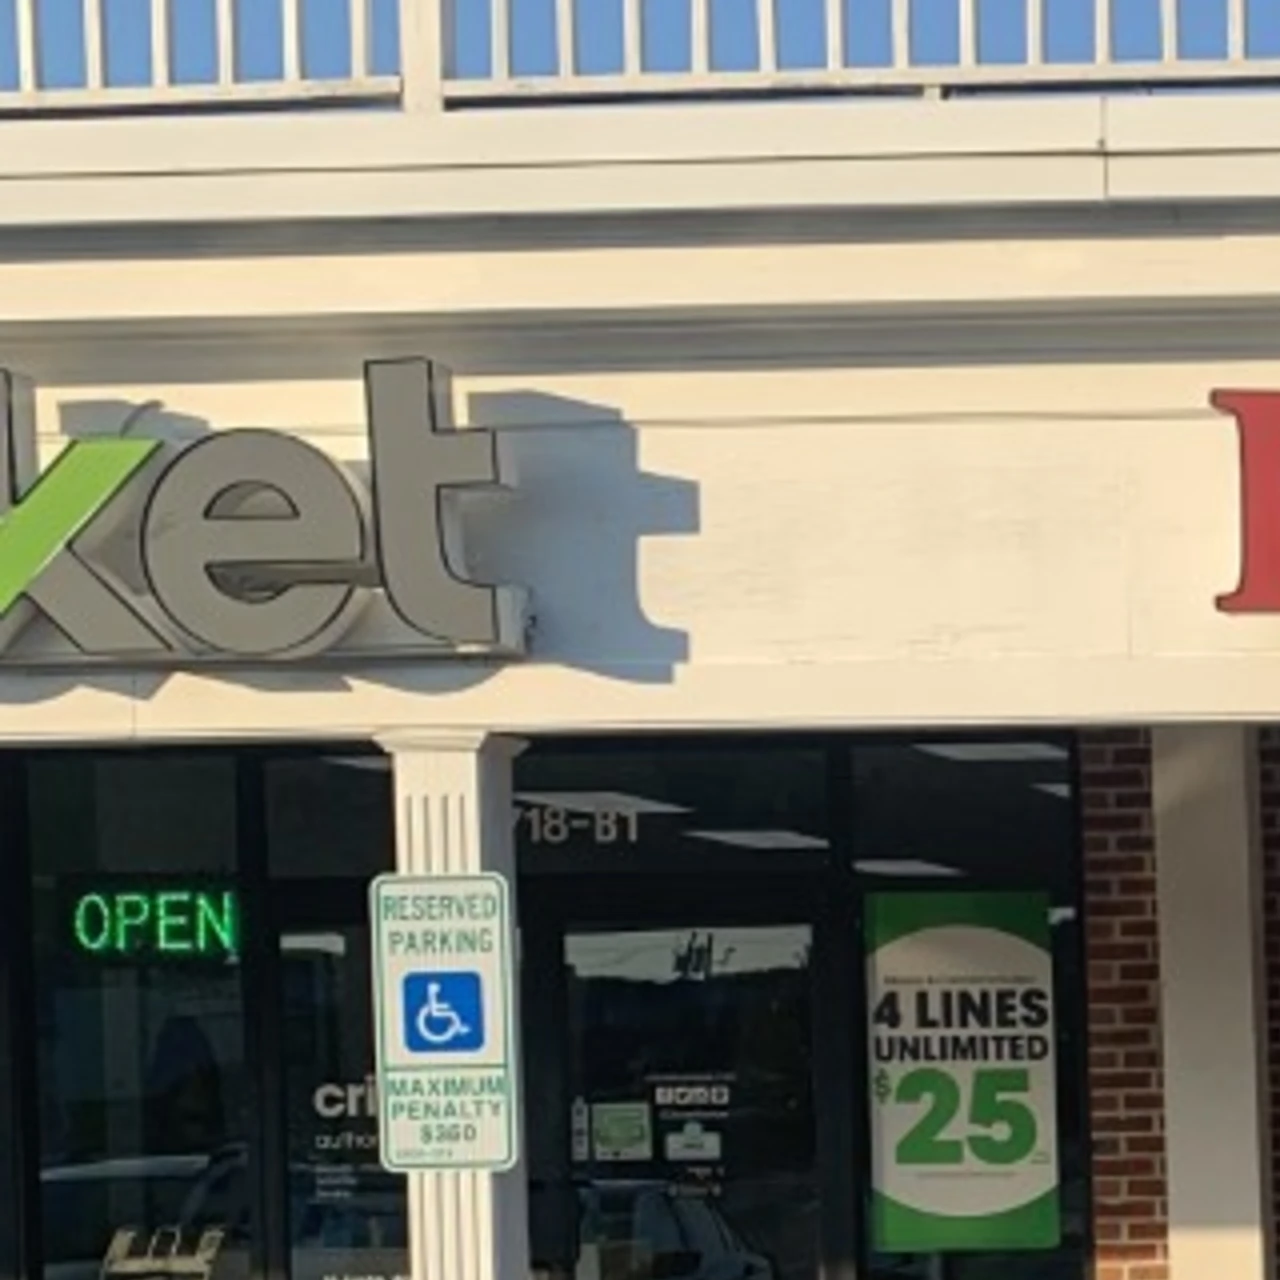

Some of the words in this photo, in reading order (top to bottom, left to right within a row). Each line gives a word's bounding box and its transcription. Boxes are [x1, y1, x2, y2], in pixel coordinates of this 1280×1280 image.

[382, 893, 498, 921] RESERVED
[74, 891, 236, 952] OPEN
[388, 928, 494, 956] PARKING
[872, 989, 902, 1030] 4
[915, 988, 1050, 1030] LINES
[874, 1034, 1050, 1062] UNLIMITED
[388, 1075, 506, 1097] MAXIMUM
[391, 1099, 502, 1121] PENALTY
